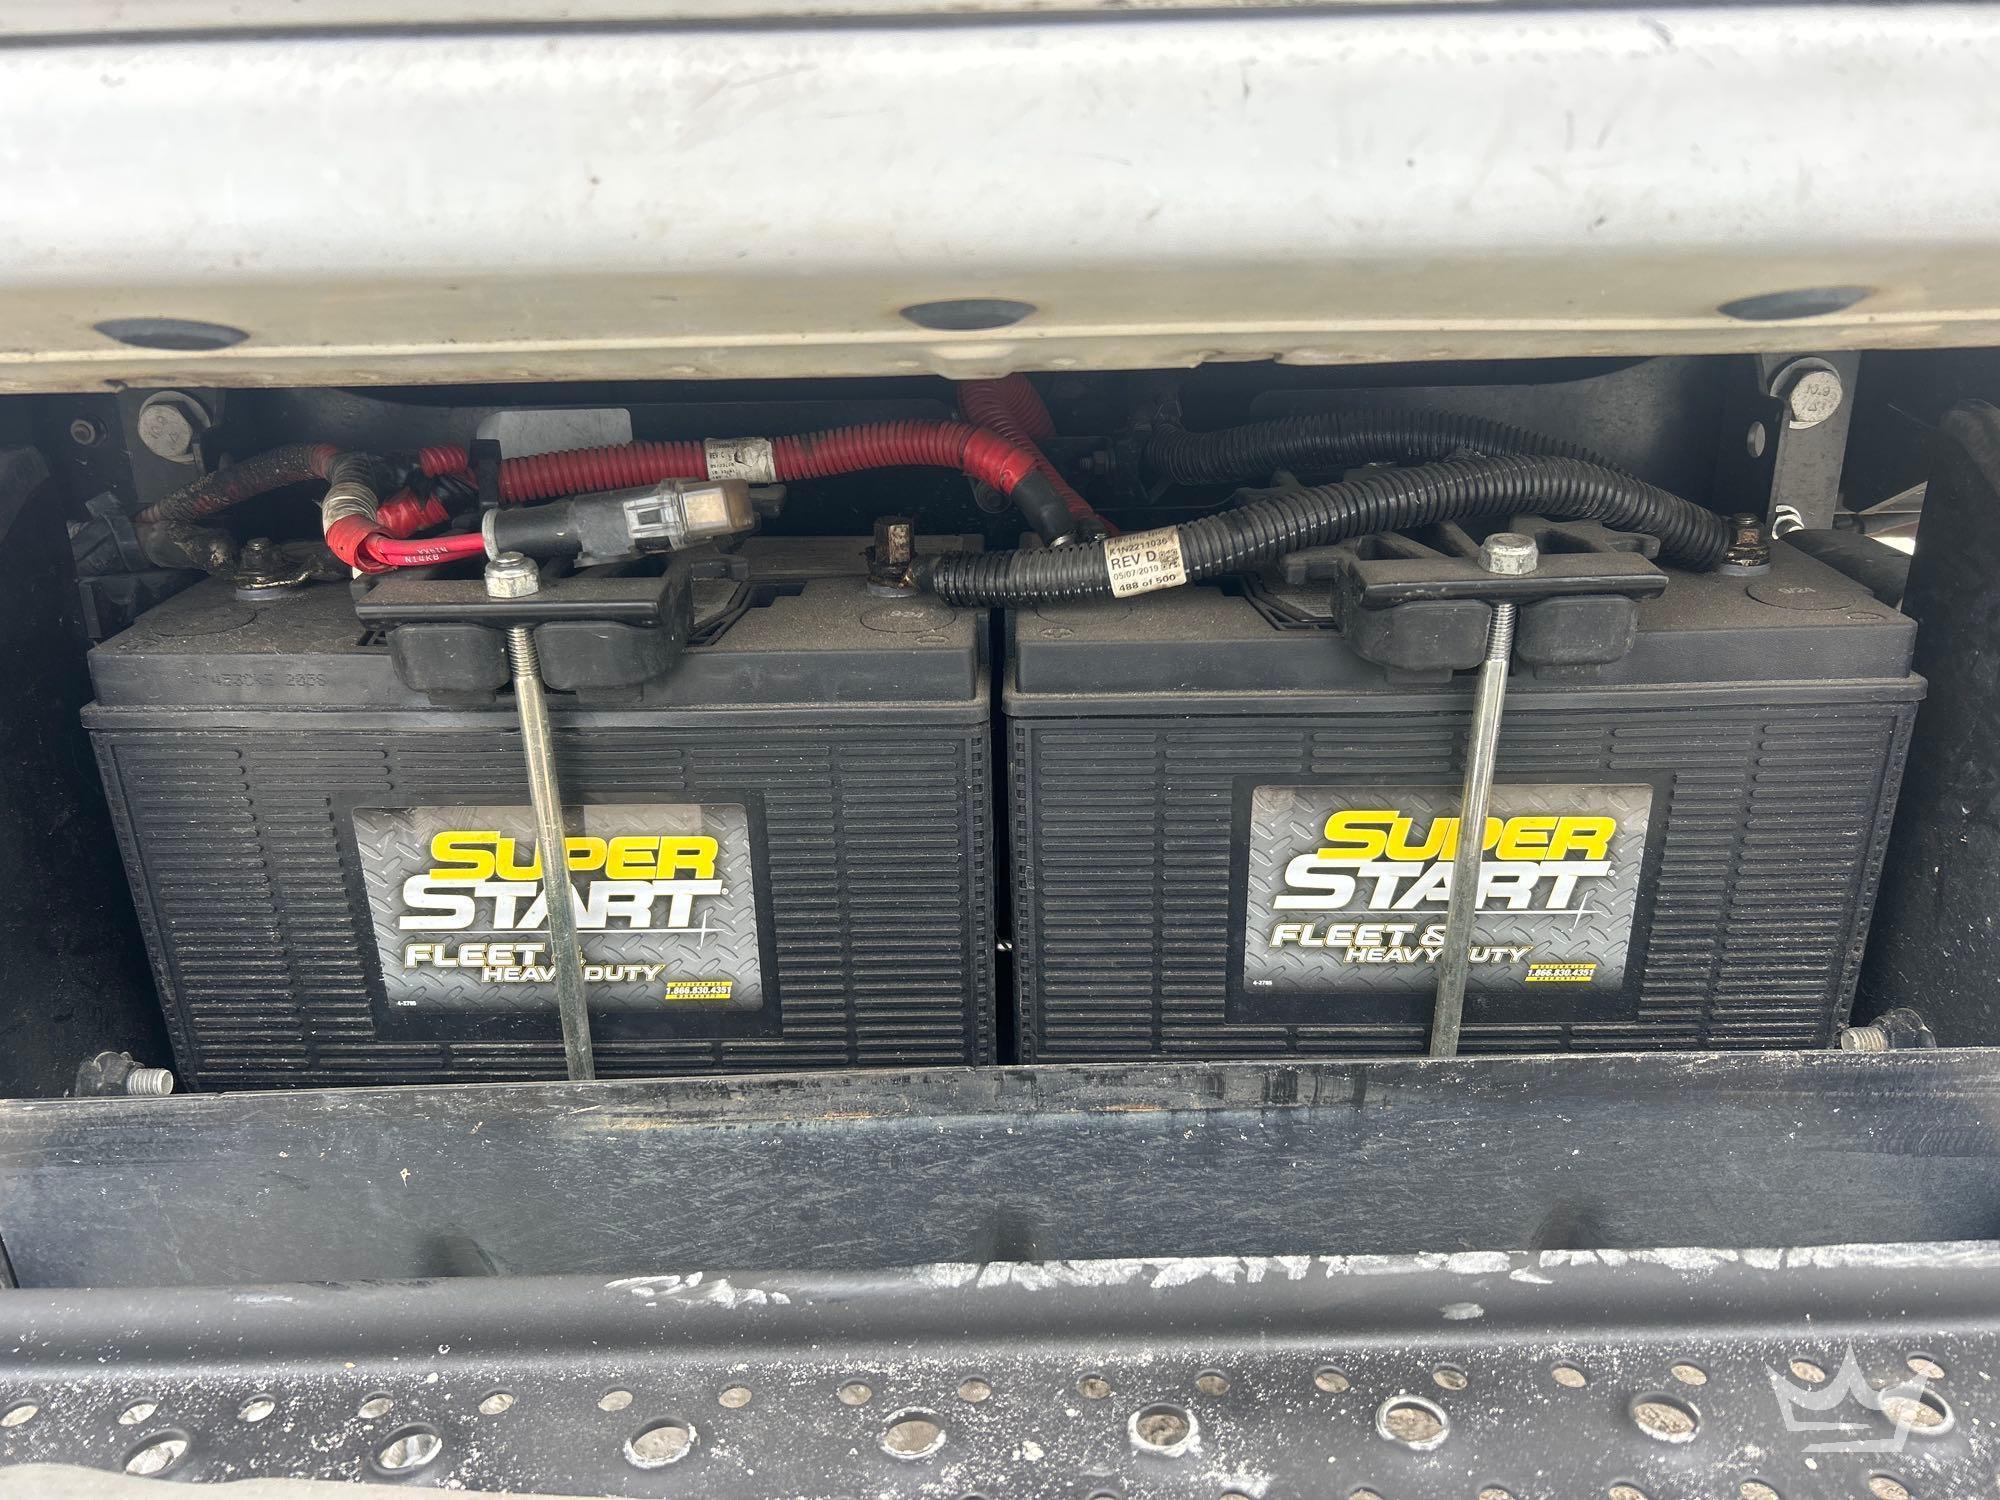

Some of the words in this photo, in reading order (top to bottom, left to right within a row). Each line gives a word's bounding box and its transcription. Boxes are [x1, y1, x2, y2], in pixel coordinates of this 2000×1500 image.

[1111, 553, 1141, 571] REV
[1146, 550, 1157, 563] D
[1113, 564, 1159, 581] 05/07/2019
[1119, 582, 1139, 592] 488
[1142, 578, 1153, 587] of
[1156, 574, 1176, 585] 500
[1317, 810, 1617, 861] SUPER
[429, 831, 719, 881] SUPER
[1271, 853, 1612, 911] START
[400, 875, 723, 931] START
[1269, 923, 1417, 948] FLEET
[404, 943, 546, 969] FLEET
[1343, 945, 1444, 964] HEAVY
[1467, 945, 1534, 964] UTY
[481, 965, 557, 983] HEAV
[583, 964, 666, 983] DUTY
[1526, 969, 1595, 977] 1.866.830.4351
[665, 986, 732, 995] 1.866.830.4351
